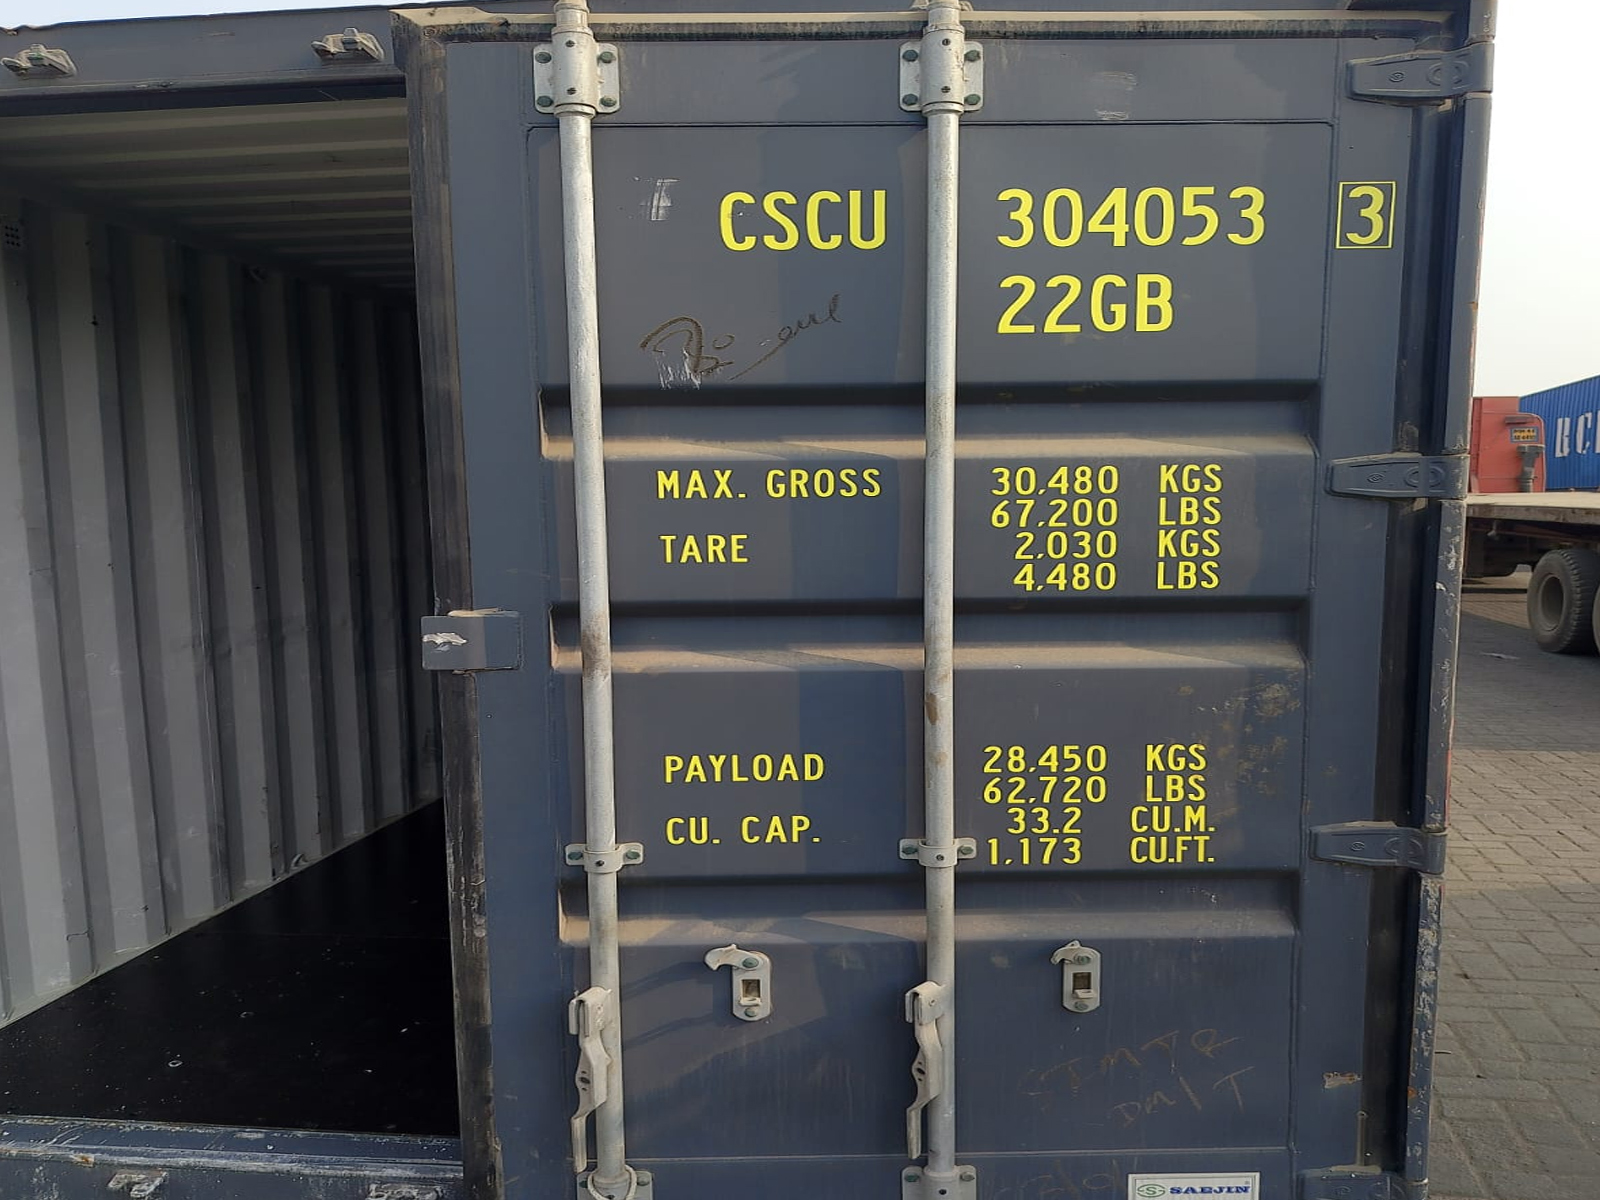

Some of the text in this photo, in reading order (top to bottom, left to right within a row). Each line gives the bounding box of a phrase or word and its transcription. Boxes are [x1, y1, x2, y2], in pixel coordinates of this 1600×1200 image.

[719, 185, 1385, 252] CSCU 304053 3
[996, 273, 1175, 335] 22GB
[1555, 410, 1600, 458] BC
[656, 463, 1223, 500] MAX. GROSS 30,480 KGS
[990, 496, 1222, 529] 67,200 LBS
[659, 528, 1222, 564] TARE 2,030 KGS
[1013, 560, 1221, 592] 4,480 LBS
[664, 743, 1208, 784] PAYLOAD 28,450 KGS
[983, 773, 1207, 805] 62,720 LBS
[665, 816, 722, 846] CU.
[740, 814, 822, 845] CAP.
[1006, 806, 1083, 836] 33.2
[1169, 1185, 1251, 1195] SAEJIN
